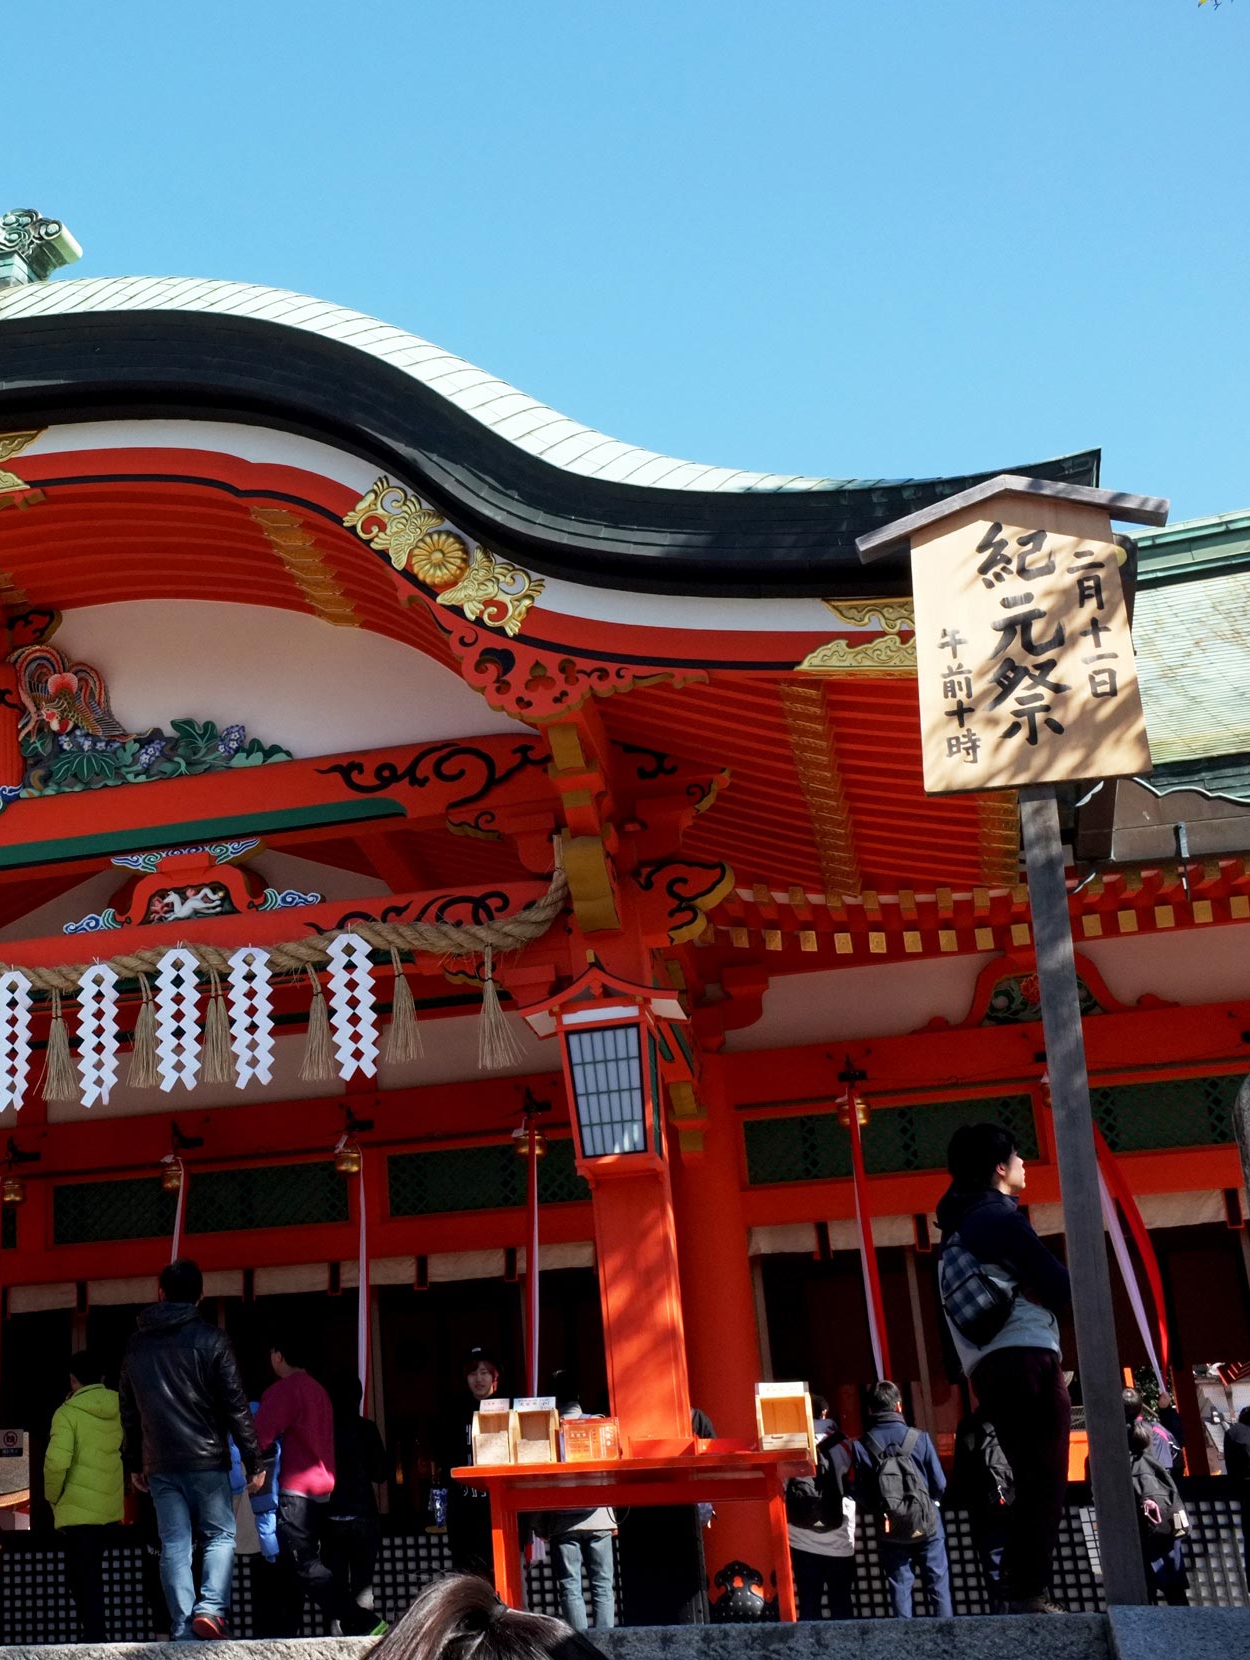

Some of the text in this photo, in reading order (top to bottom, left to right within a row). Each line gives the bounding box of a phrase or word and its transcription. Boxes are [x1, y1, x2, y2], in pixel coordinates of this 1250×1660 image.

[937, 628, 982, 764] 午前十時
[975, 521, 1072, 746] 紀元祭
[1067, 550, 1119, 699] 二月十一日
